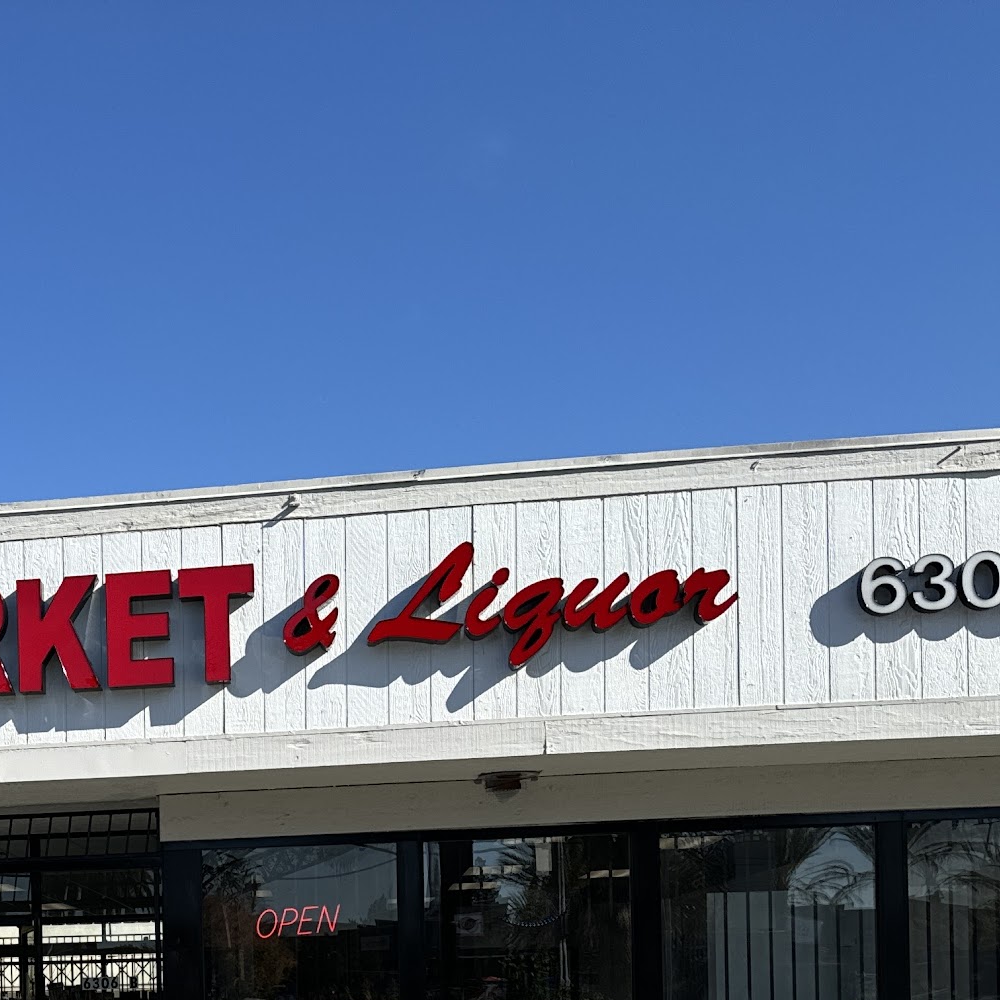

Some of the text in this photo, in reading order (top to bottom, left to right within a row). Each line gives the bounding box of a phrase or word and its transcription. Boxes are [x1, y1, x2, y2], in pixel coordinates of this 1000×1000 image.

[282, 574, 339, 655] &
[367, 541, 738, 670] Liquor
[857, 551, 1000, 616] 630
[257, 904, 340, 938] OPEN
[84, 977, 138, 989] 6306 B
